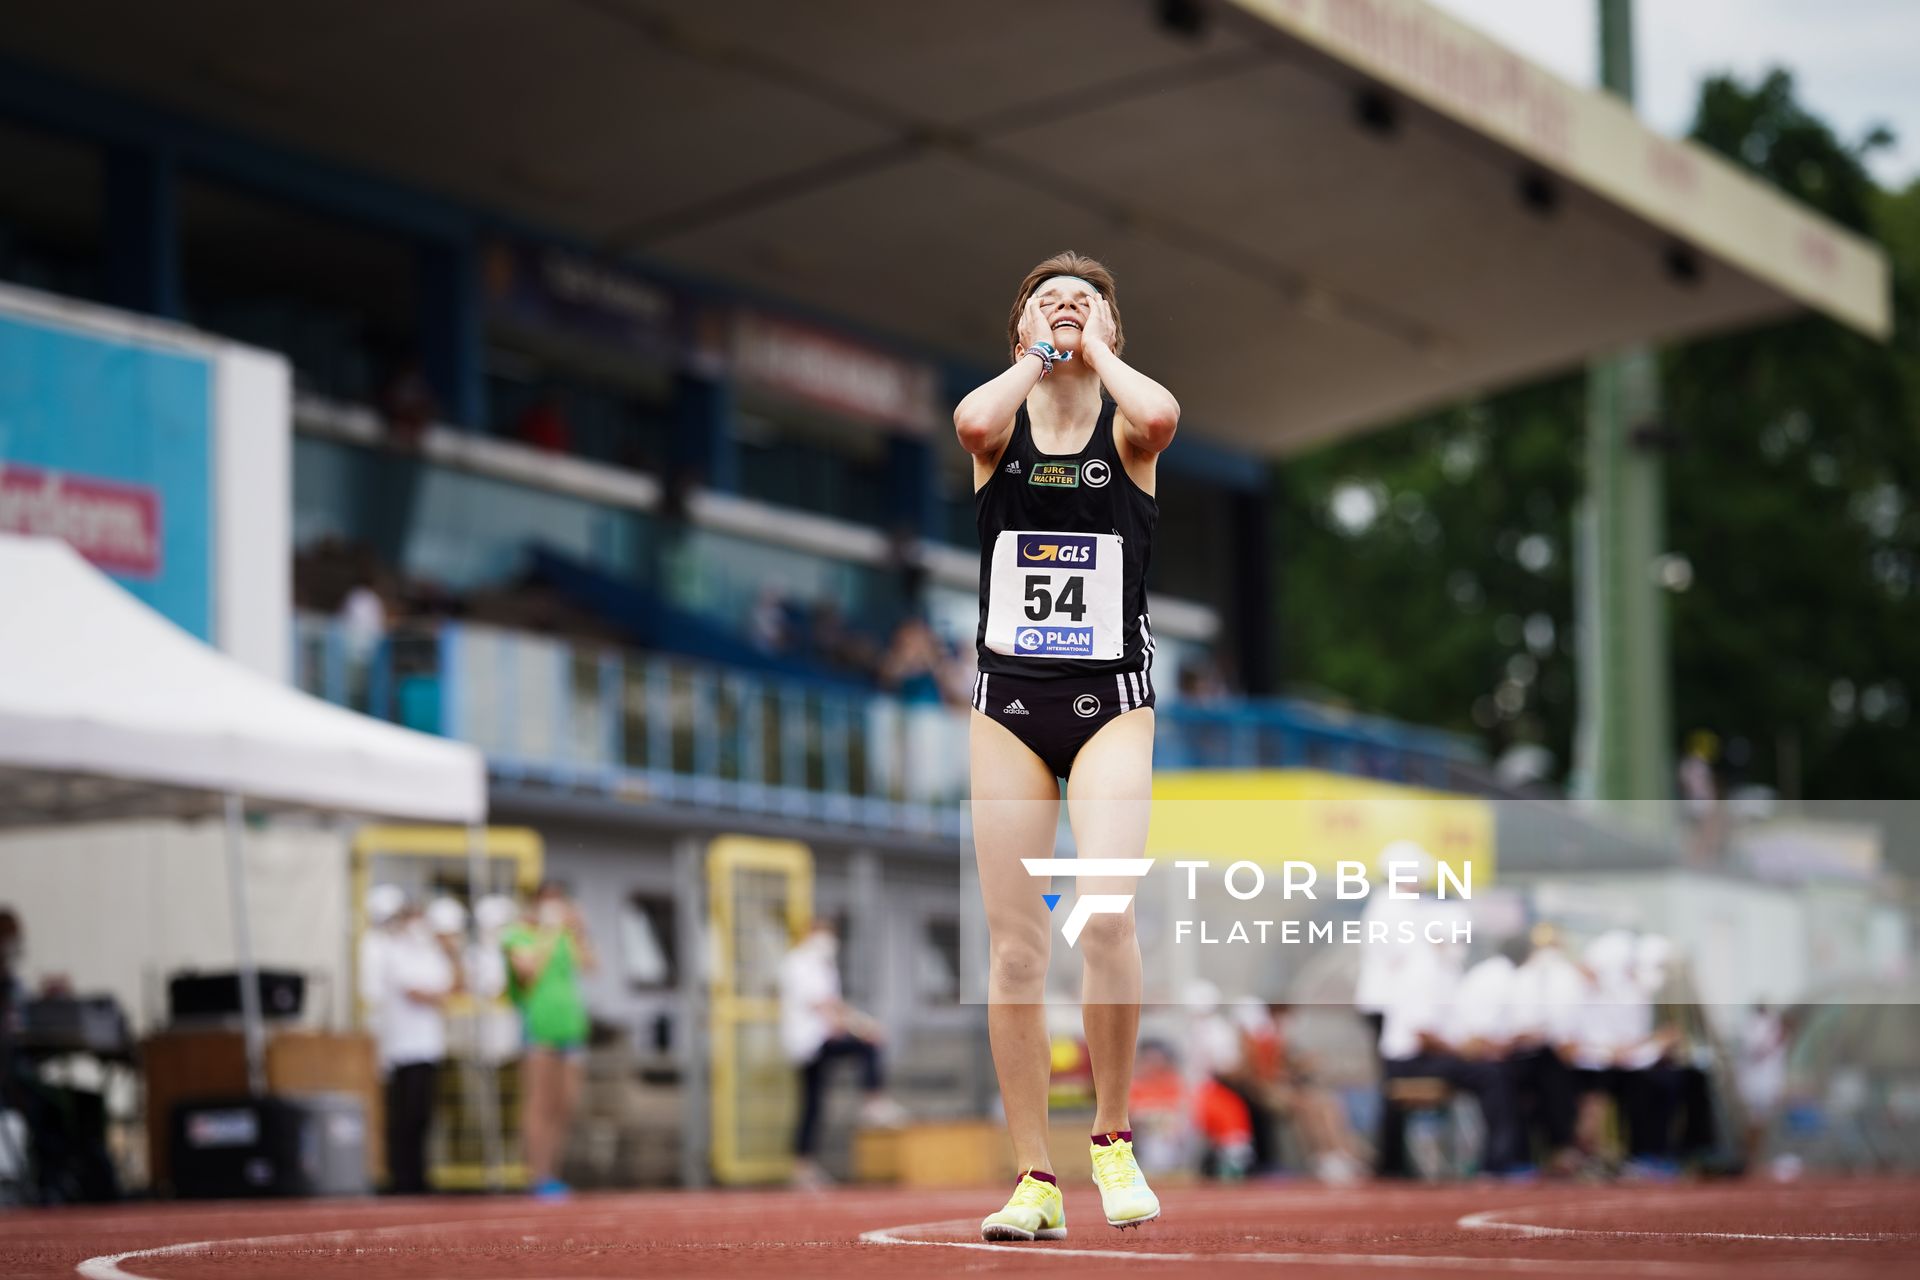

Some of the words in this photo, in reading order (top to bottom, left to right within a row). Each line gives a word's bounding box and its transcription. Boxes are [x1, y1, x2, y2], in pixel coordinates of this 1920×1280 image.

[1058, 545, 1091, 563] GLS
[1024, 575, 1086, 621] 54
[1046, 631, 1090, 646] PLAN
[1003, 708, 1030, 716] adidas
